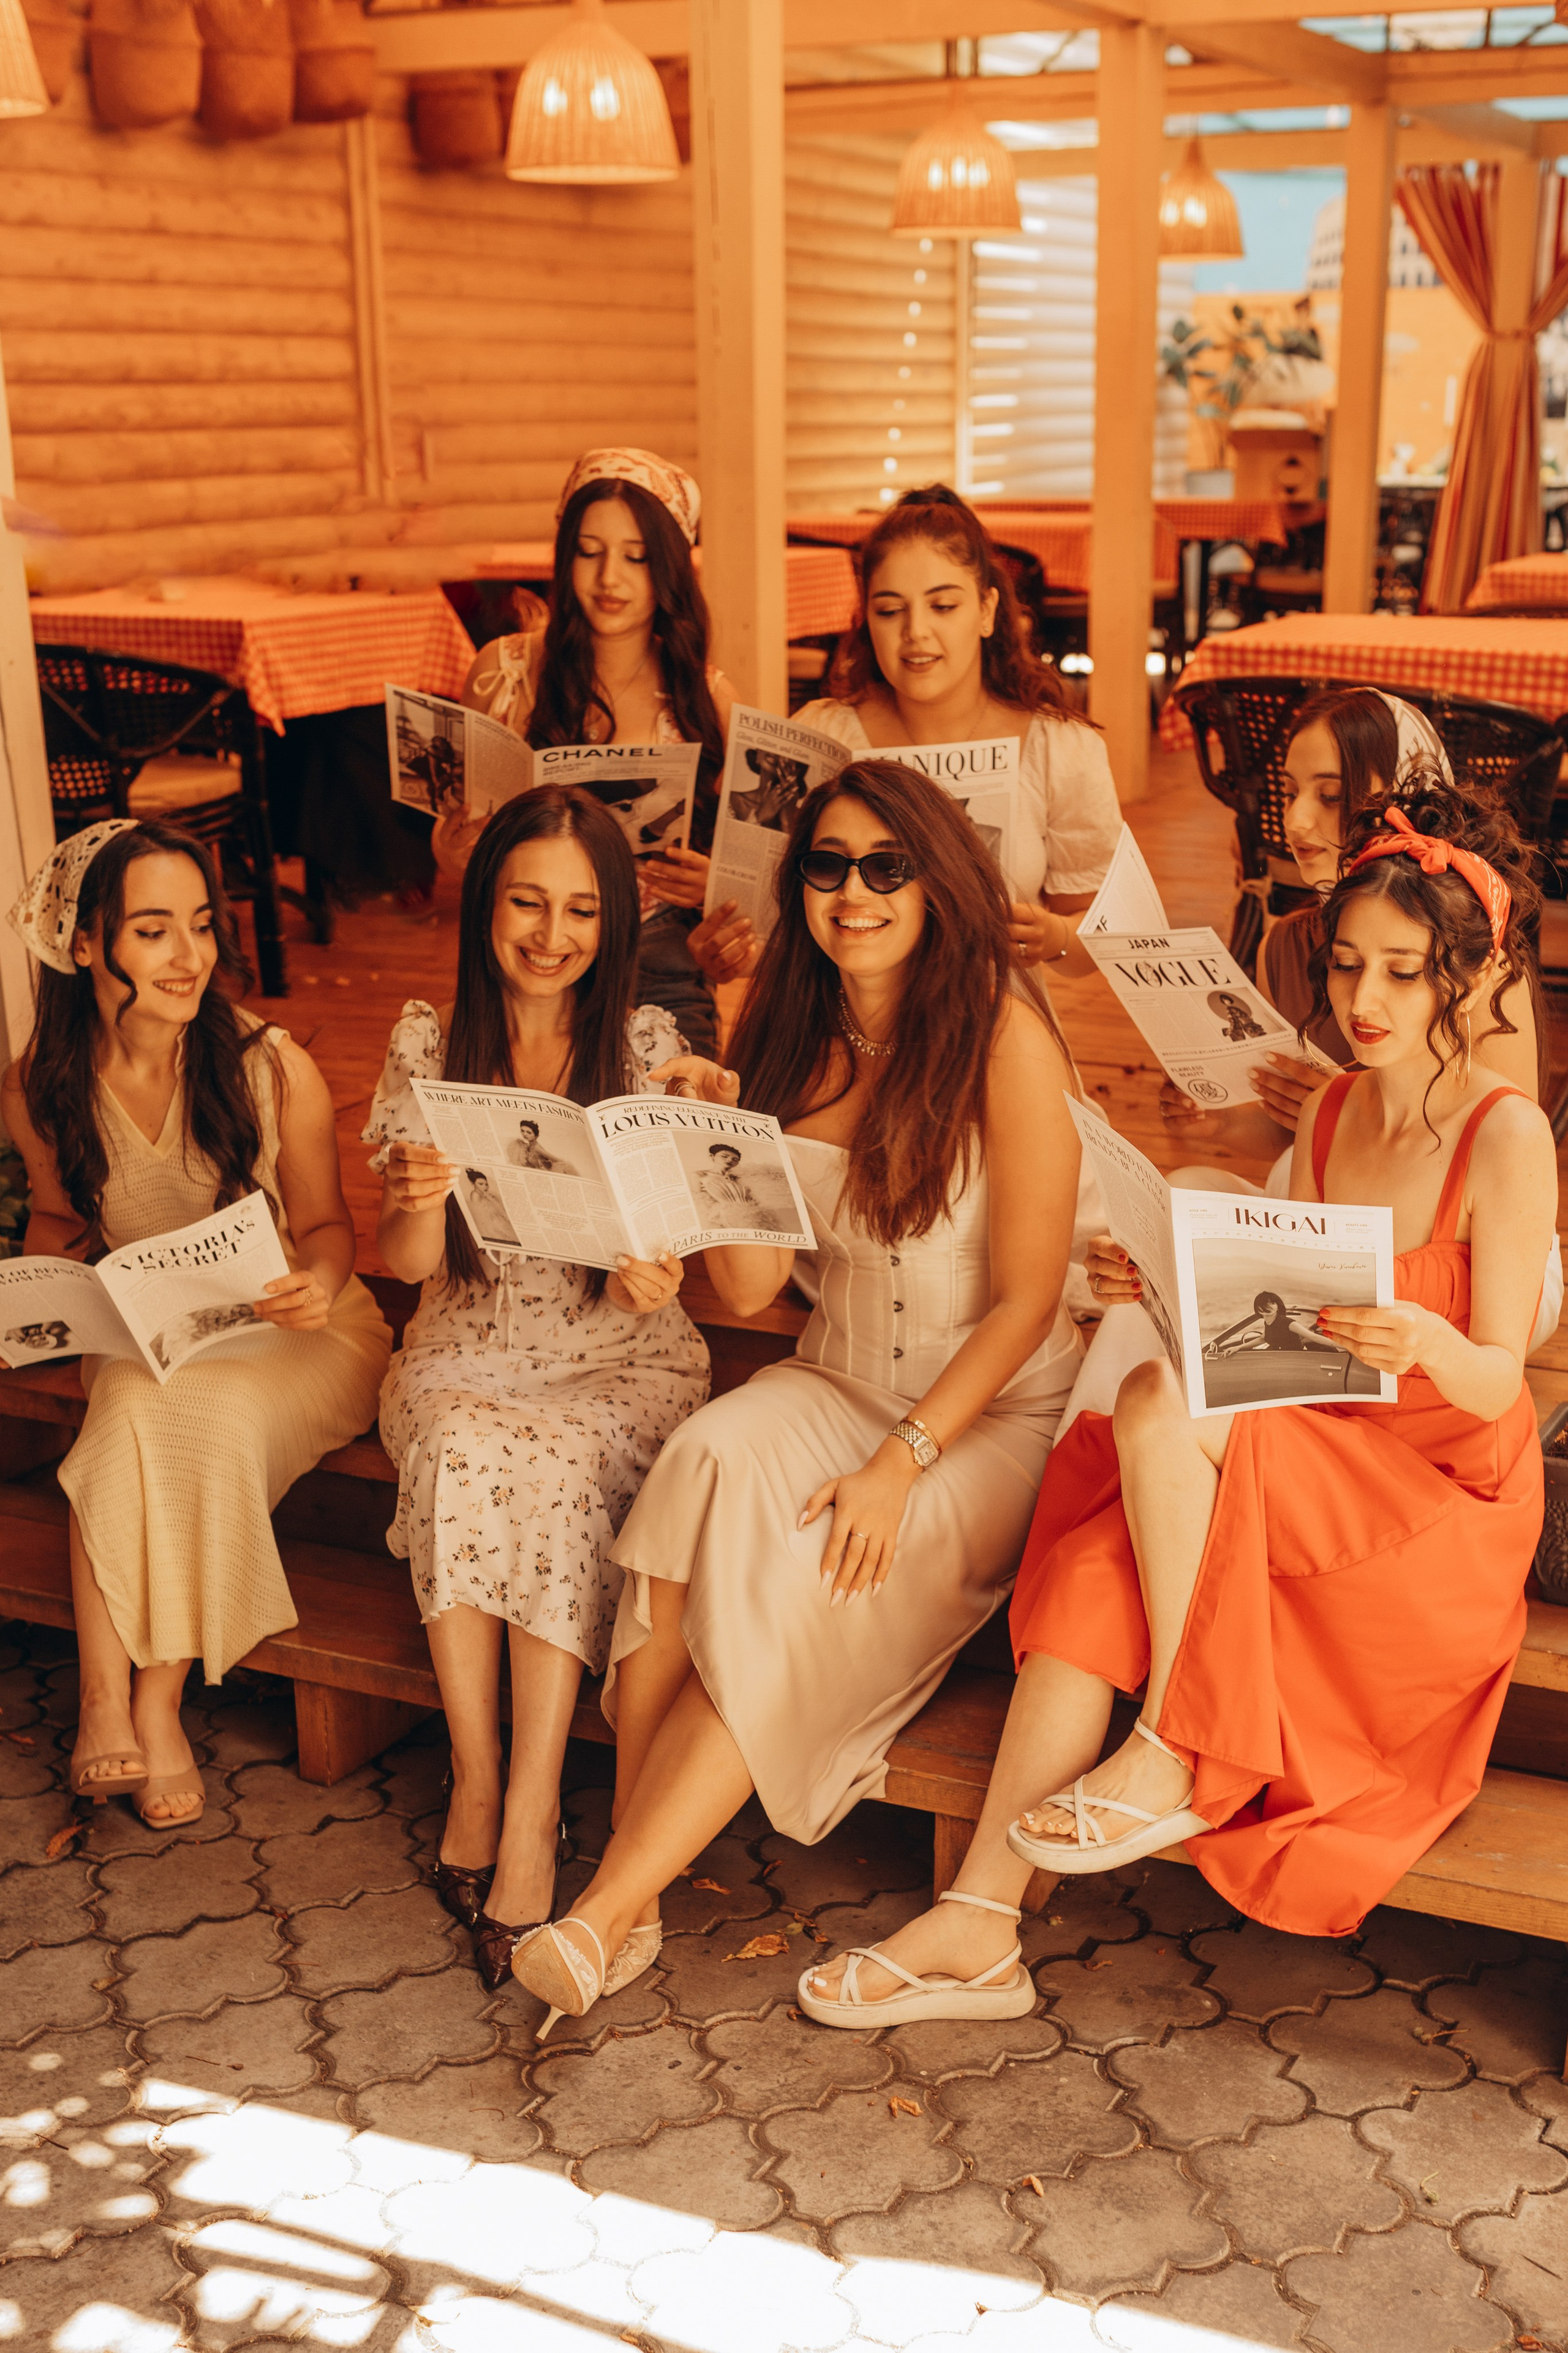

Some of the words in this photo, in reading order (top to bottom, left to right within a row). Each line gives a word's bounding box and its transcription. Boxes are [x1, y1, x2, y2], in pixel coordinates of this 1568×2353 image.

[739, 712, 784, 736] POLISH
[543, 748, 662, 763] CHANEL
[1128, 937, 1170, 950] JAPAN
[1114, 959, 1232, 989] VOGUE
[423, 1091, 467, 1105] WHERE
[469, 1096, 492, 1106] ART
[496, 1099, 537, 1111] MEETS
[538, 1103, 586, 1125] FASHION
[623, 1105, 675, 1114] REDEFINING
[676, 1106, 723, 1117] ELEGANCE
[724, 1114, 747, 1124] WITH
[601, 1112, 670, 1138] LOUIS
[674, 1114, 775, 1141] VUITTON
[1235, 1207, 1326, 1235] IKIGAI
[673, 1231, 712, 1252] PARIS
[753, 1231, 807, 1243] WORLD
[143, 1239, 241, 1275] SECRET
[33, 1267, 81, 1278] BEING
